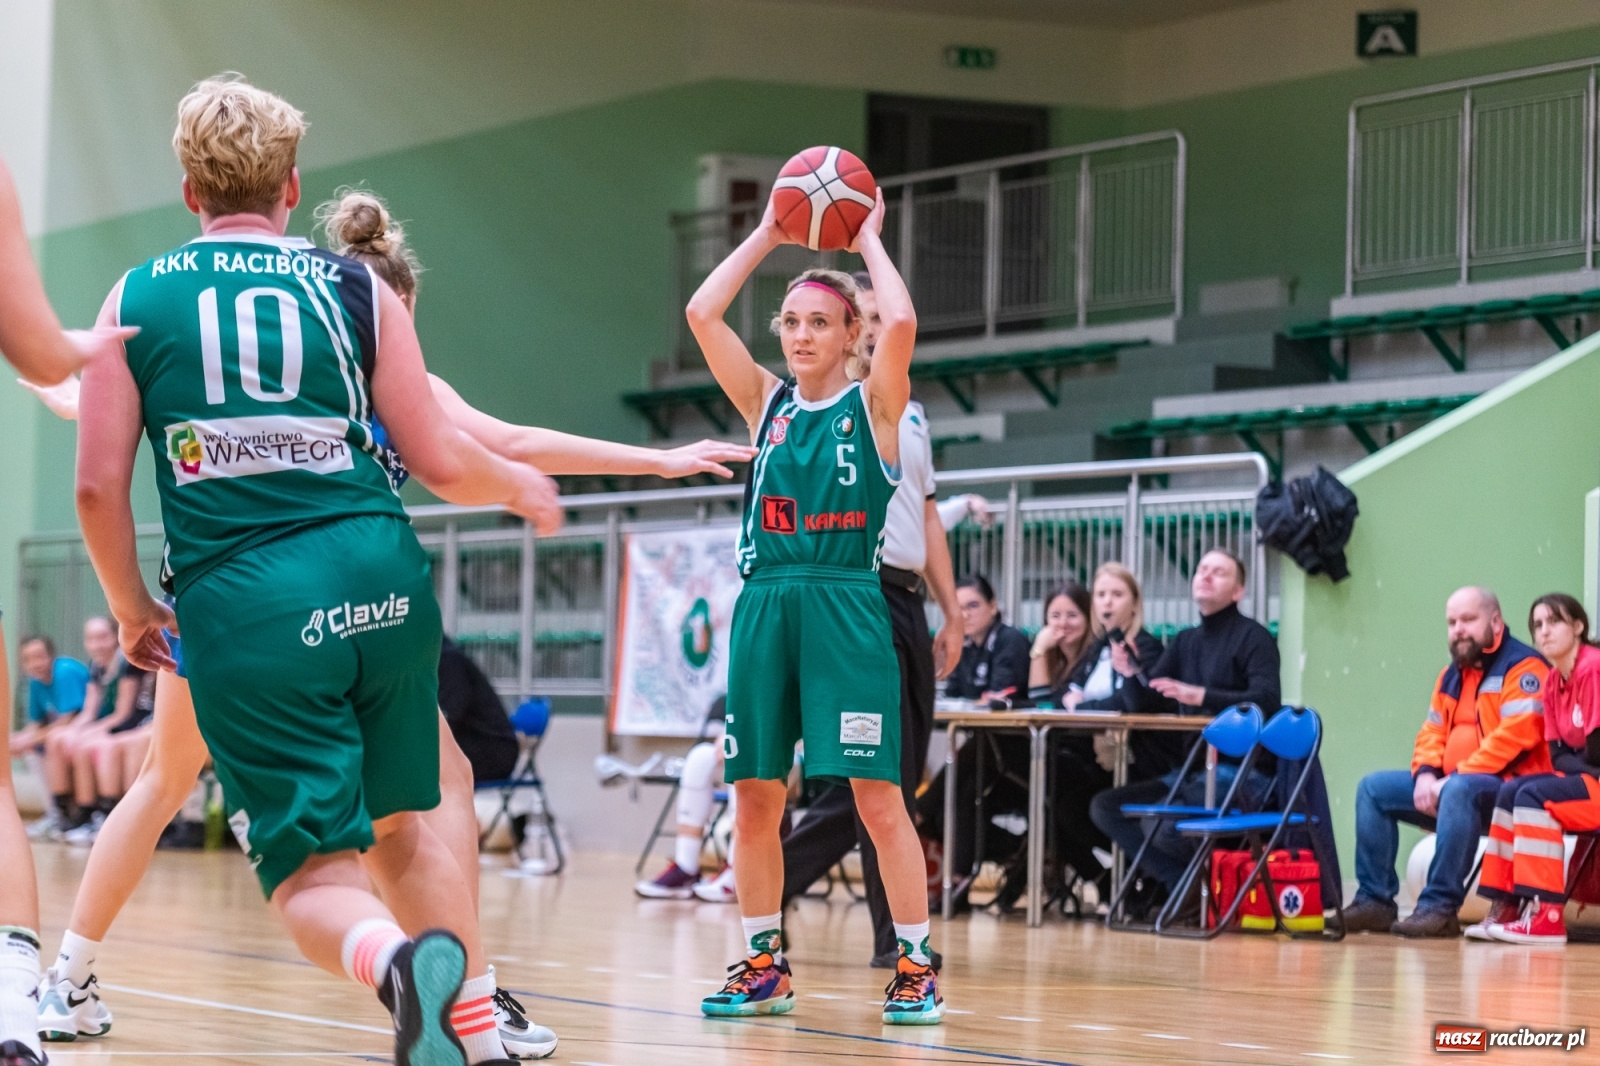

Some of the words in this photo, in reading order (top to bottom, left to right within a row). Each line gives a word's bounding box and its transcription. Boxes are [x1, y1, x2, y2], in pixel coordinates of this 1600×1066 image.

[1365, 25, 1406, 53] A
[152, 251, 199, 278] RKK
[197, 286, 304, 405] 10
[836, 444, 857, 486] 5
[765, 501, 793, 530] K
[804, 511, 867, 531] KAMAN
[327, 592, 410, 634] Clavis
[843, 749, 875, 757] COLO
